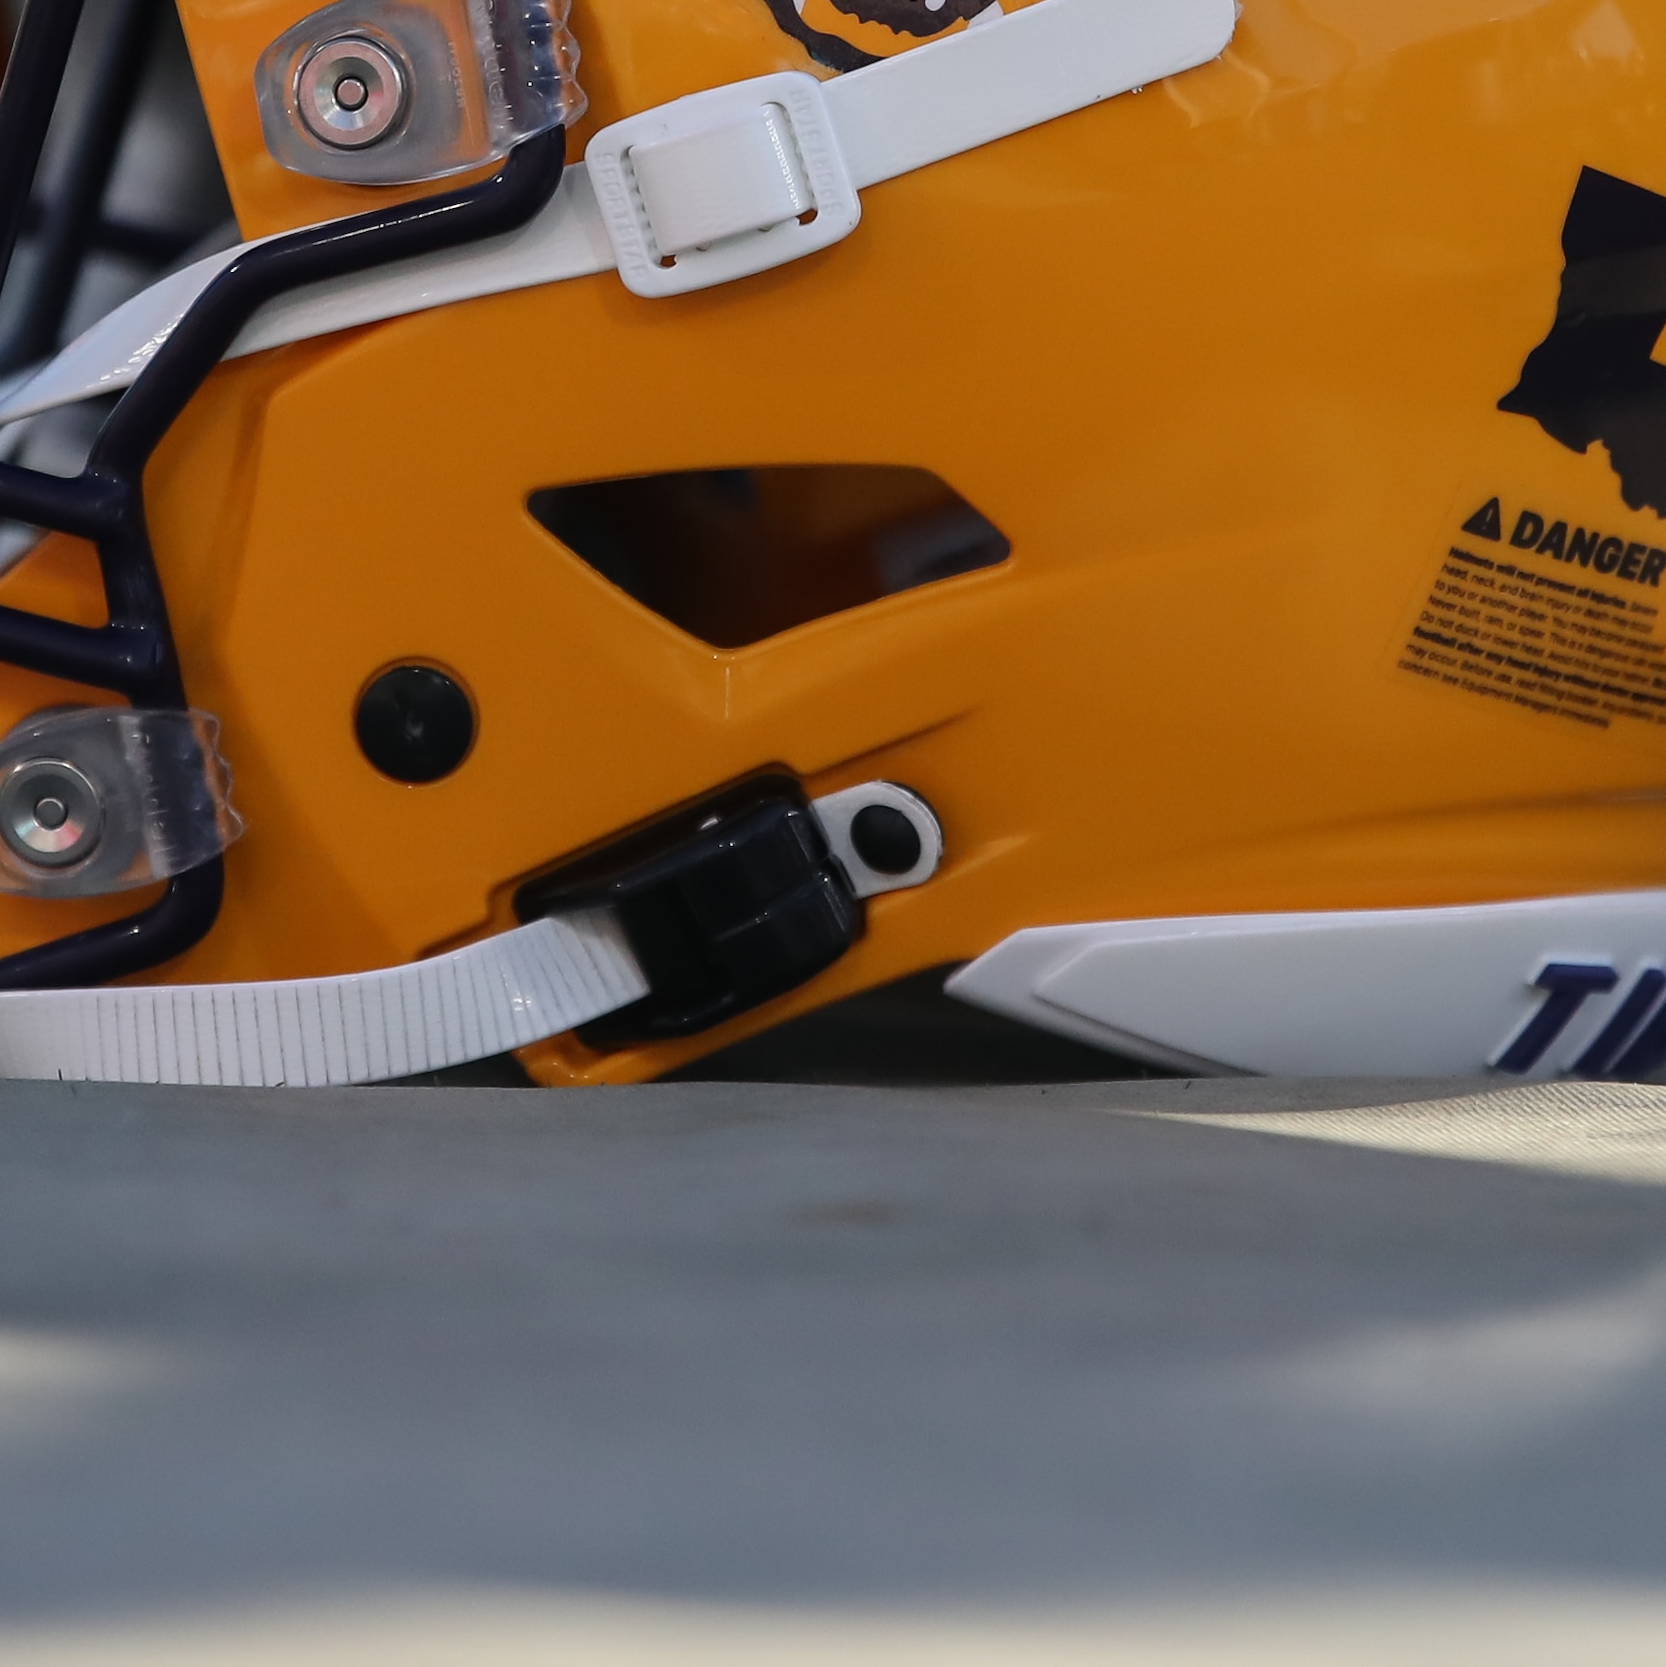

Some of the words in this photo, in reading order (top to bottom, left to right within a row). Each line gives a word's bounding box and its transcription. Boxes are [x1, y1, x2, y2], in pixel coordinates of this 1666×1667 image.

[1496, 564, 1517, 576] will
[1535, 577, 1576, 594] prevent
[1428, 595, 1457, 611] Never
[1479, 596, 1517, 612] another
[1518, 588, 1544, 601] brain
[1545, 597, 1572, 613] injury
[1454, 623, 1479, 637] duck
[1493, 635, 1519, 649] lower
[1457, 642, 1485, 656] after
